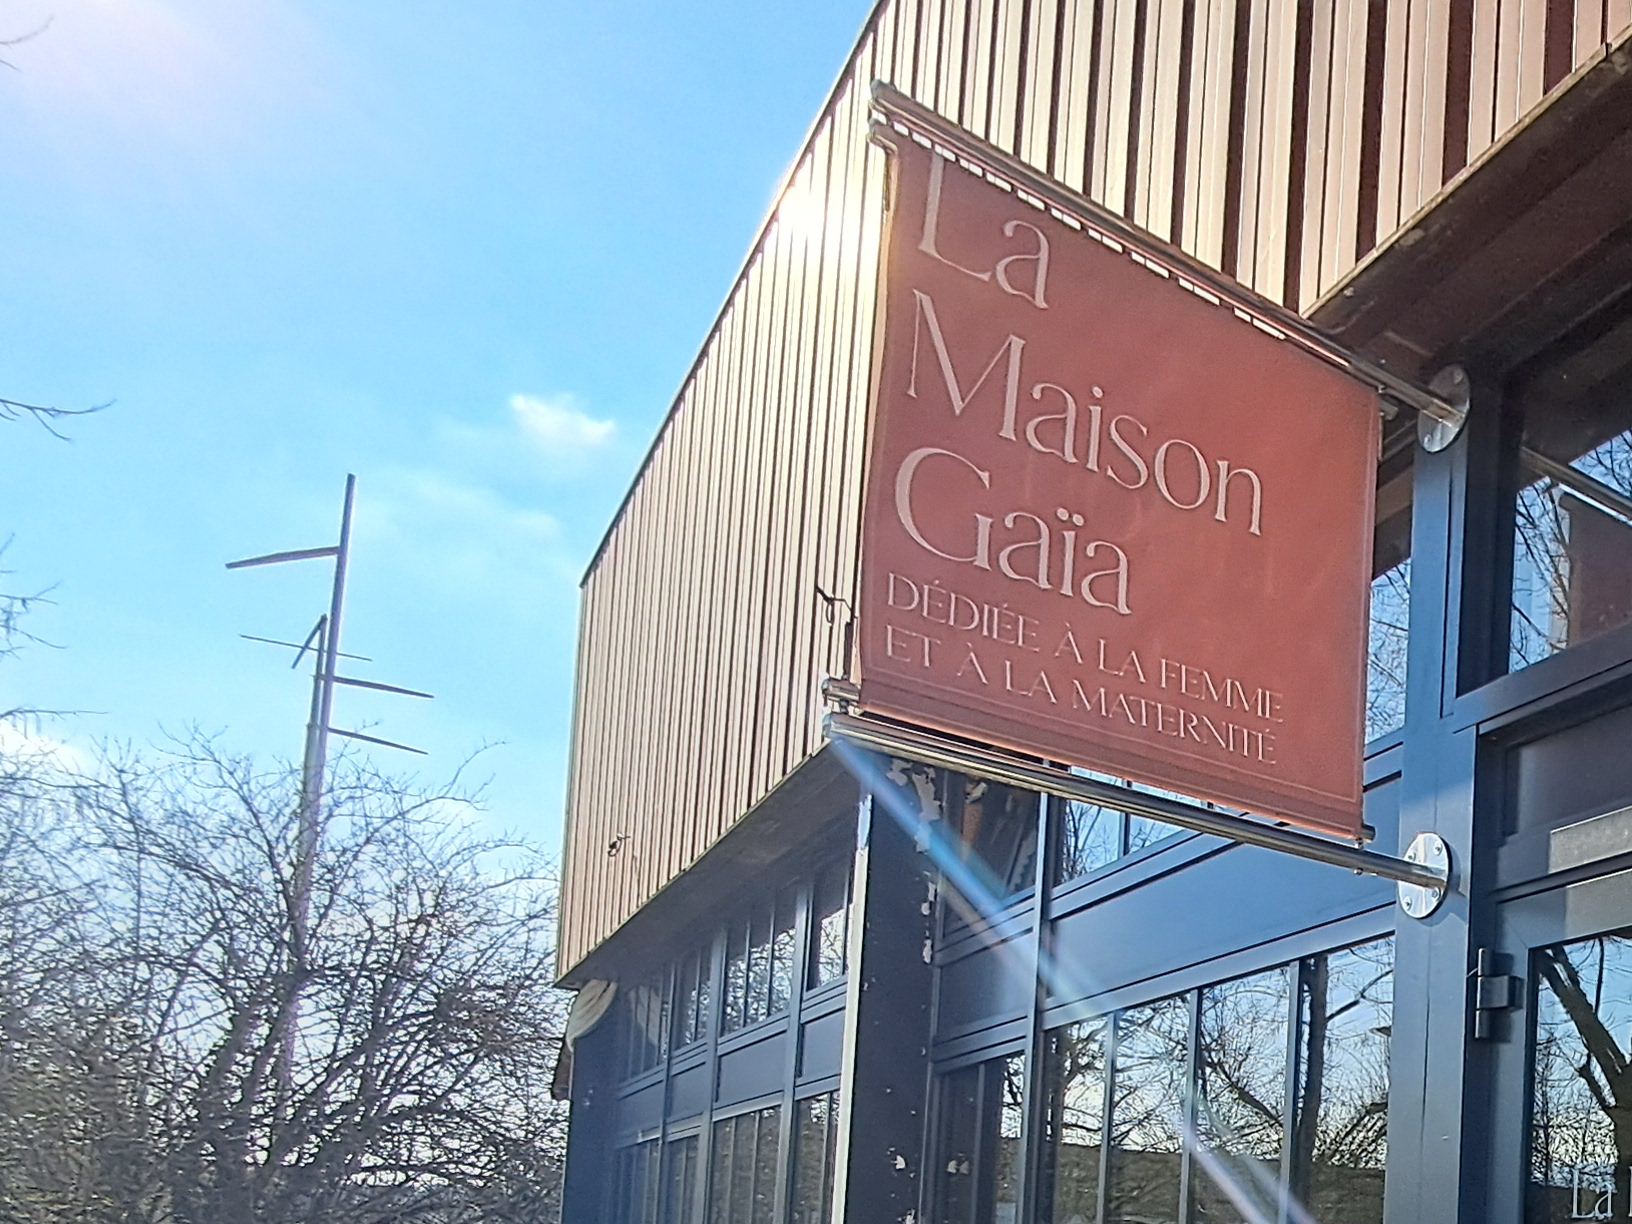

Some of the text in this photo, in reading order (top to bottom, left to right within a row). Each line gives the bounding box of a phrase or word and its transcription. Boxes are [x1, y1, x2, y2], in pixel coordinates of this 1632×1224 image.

[918, 148, 1049, 310] La
[906, 288, 1263, 537] Maison
[895, 446, 1132, 615] Gaïa
[886, 571, 1284, 724] DÉDIÉE À LA FEMME
[886, 623, 1278, 765] ET À LA MATERNITÉ
[1570, 1167, 1614, 1220] La
